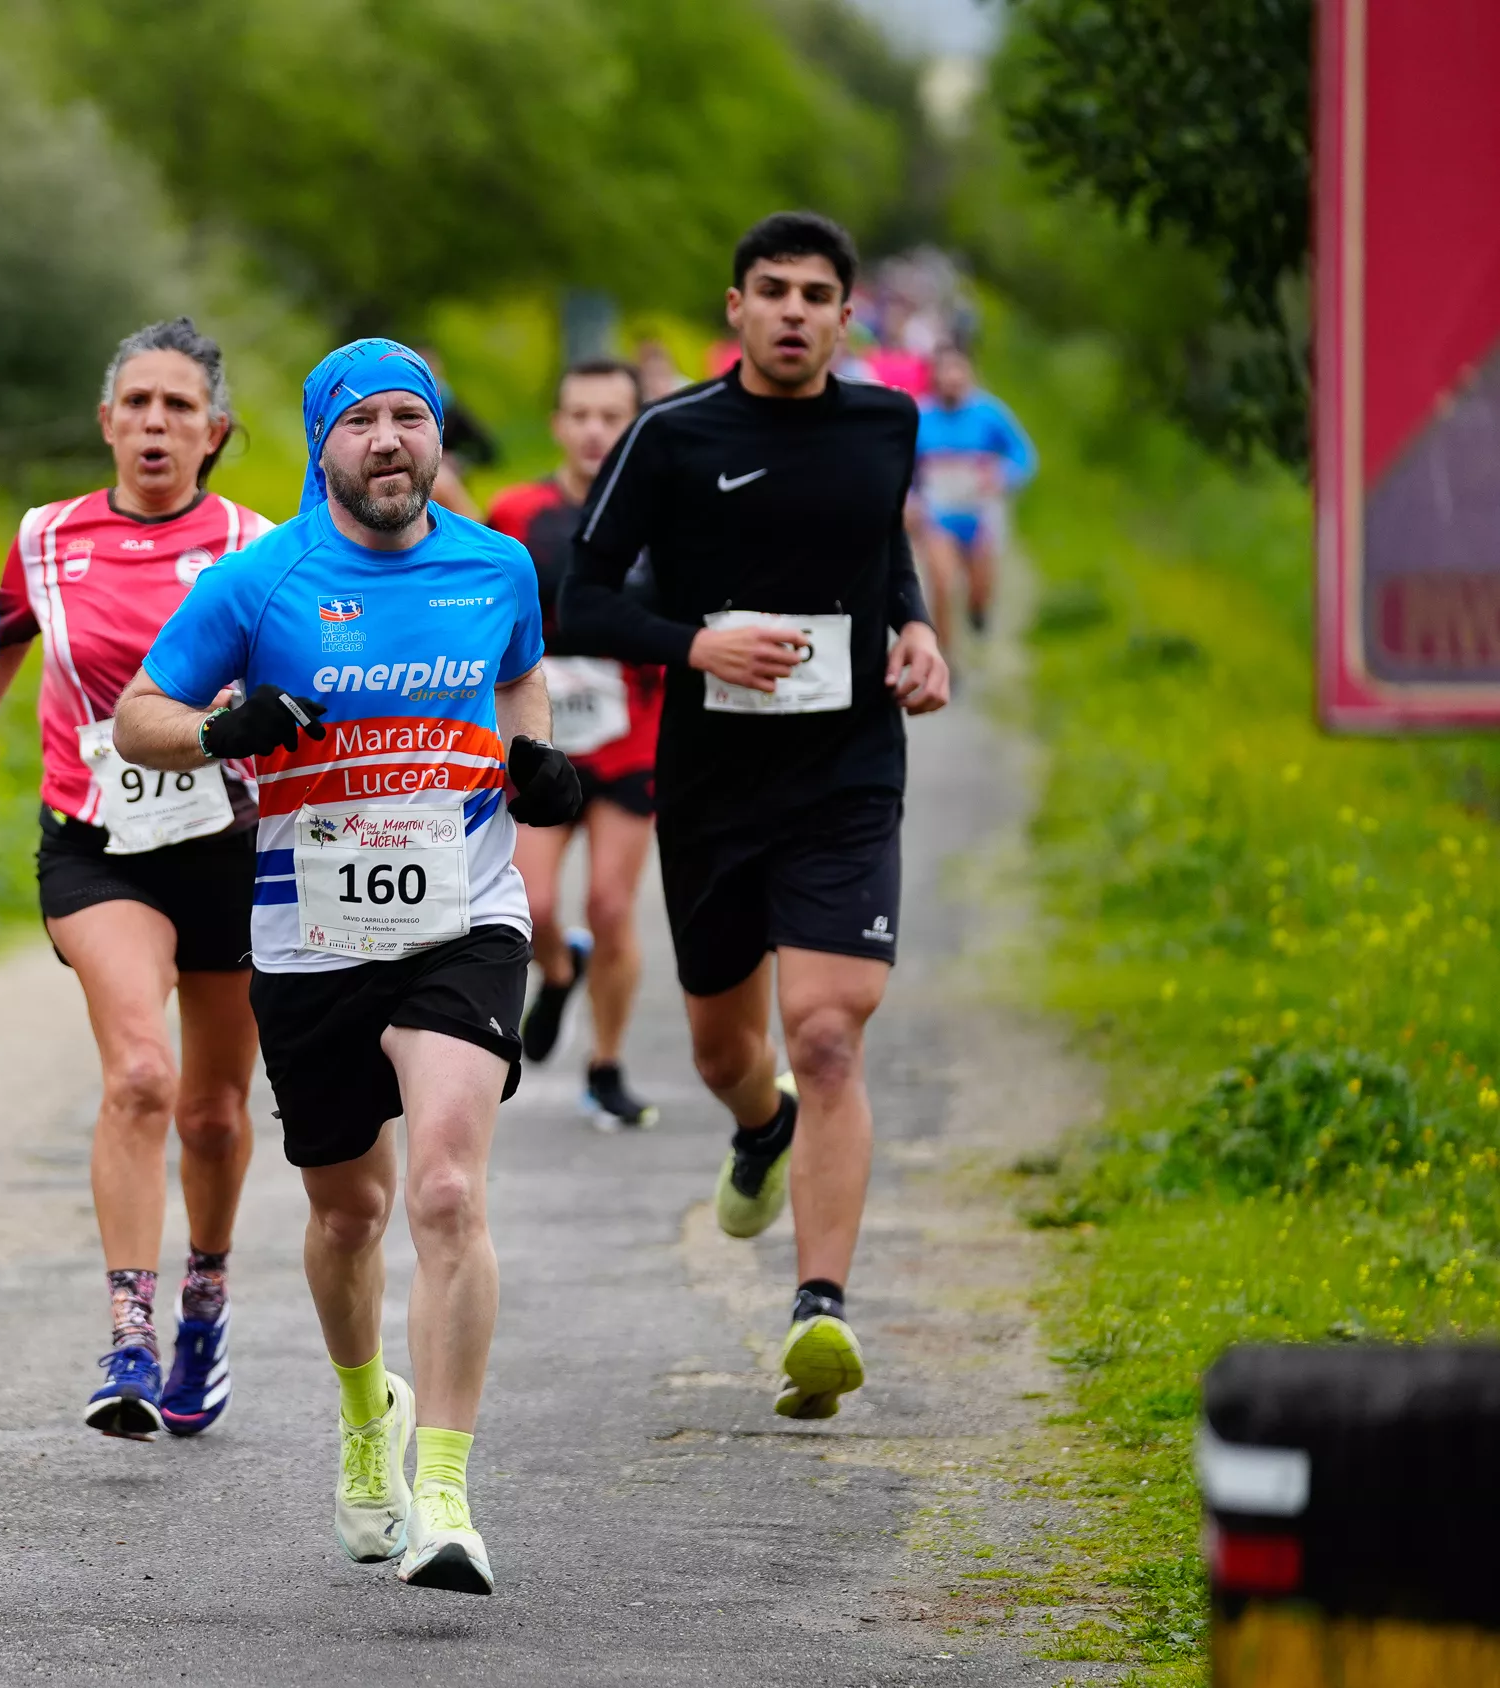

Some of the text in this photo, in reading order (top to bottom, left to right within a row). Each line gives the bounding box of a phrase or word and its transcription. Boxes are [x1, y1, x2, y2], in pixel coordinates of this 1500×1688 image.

[428, 597, 484, 607] GSPORT
[320, 621, 348, 633] Club
[321, 630, 367, 642] Maratón
[321, 641, 364, 653] Lucena
[312, 655, 486, 697] enerplus
[408, 688, 478, 702] directo
[344, 766, 450, 796] Lucena
[382, 818, 424, 831] MARATÓN
[360, 832, 417, 849] LUCENA
[338, 863, 427, 905] 160
[342, 914, 360, 922] DAVID
[361, 916, 390, 924] CARRILLO
